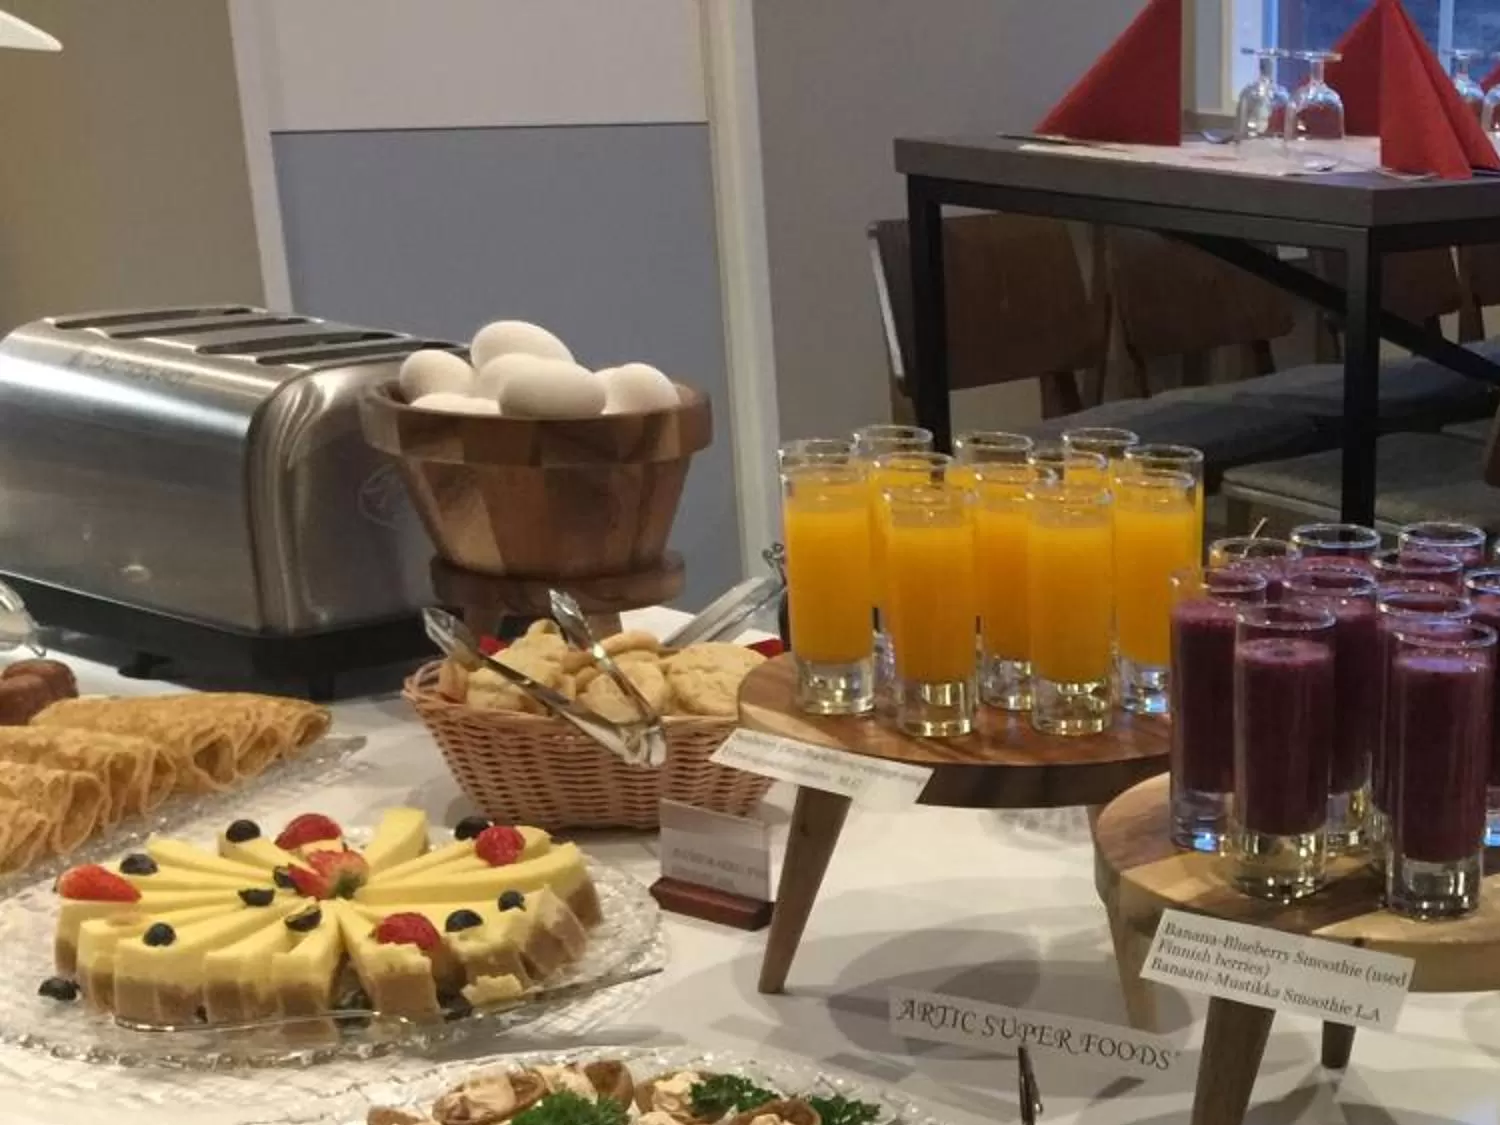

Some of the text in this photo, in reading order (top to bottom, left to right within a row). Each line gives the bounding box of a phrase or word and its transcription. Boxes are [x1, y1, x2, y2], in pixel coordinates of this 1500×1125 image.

[1158, 939, 1271, 979] Finnish berries)
[1293, 950, 1363, 977] Smoothie
[1365, 964, 1408, 988] (used
[1282, 987, 1353, 1016] Smoothie
[896, 999, 977, 1034] ARTIC
[981, 1013, 1078, 1057] SUPER
